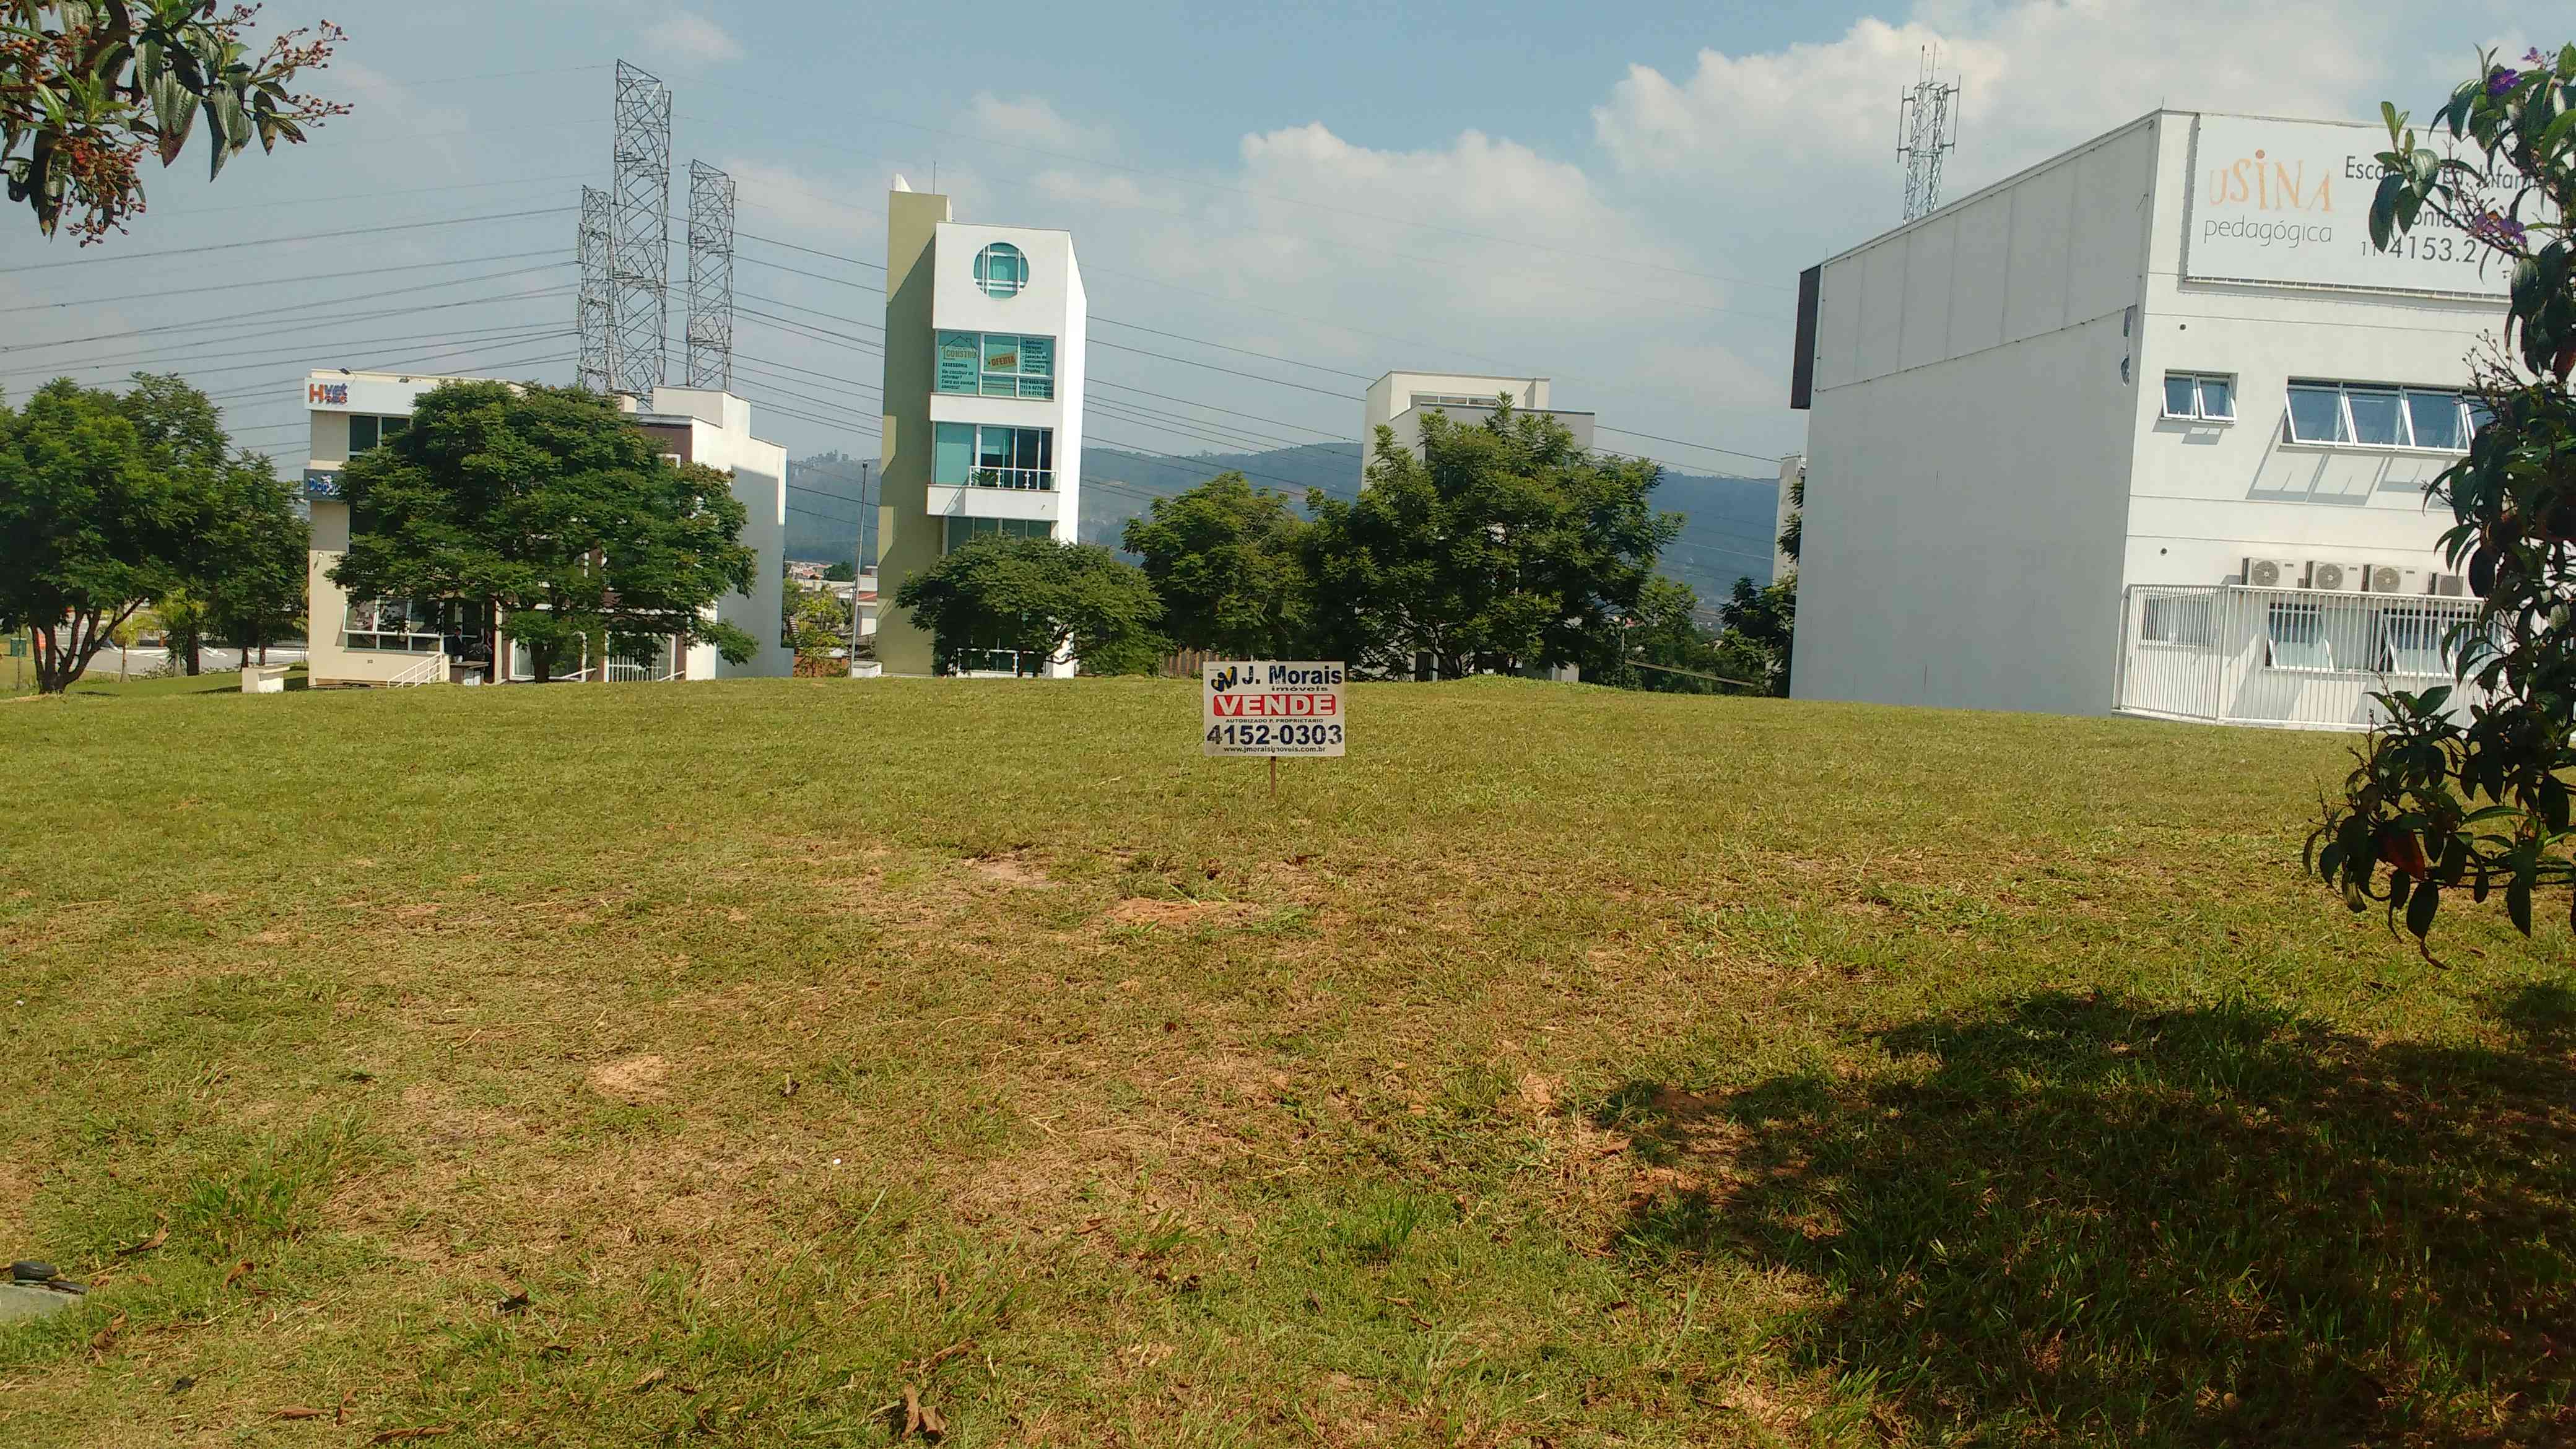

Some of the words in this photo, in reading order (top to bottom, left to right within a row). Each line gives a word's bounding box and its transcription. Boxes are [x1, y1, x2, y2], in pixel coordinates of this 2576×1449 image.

[2204, 214, 2332, 248] pedagógica
[1242, 666, 1261, 685] J.
[1269, 666, 1342, 685] Morais
[1216, 695, 1333, 716] VENDE
[1206, 724, 1342, 745] 4152-0303
